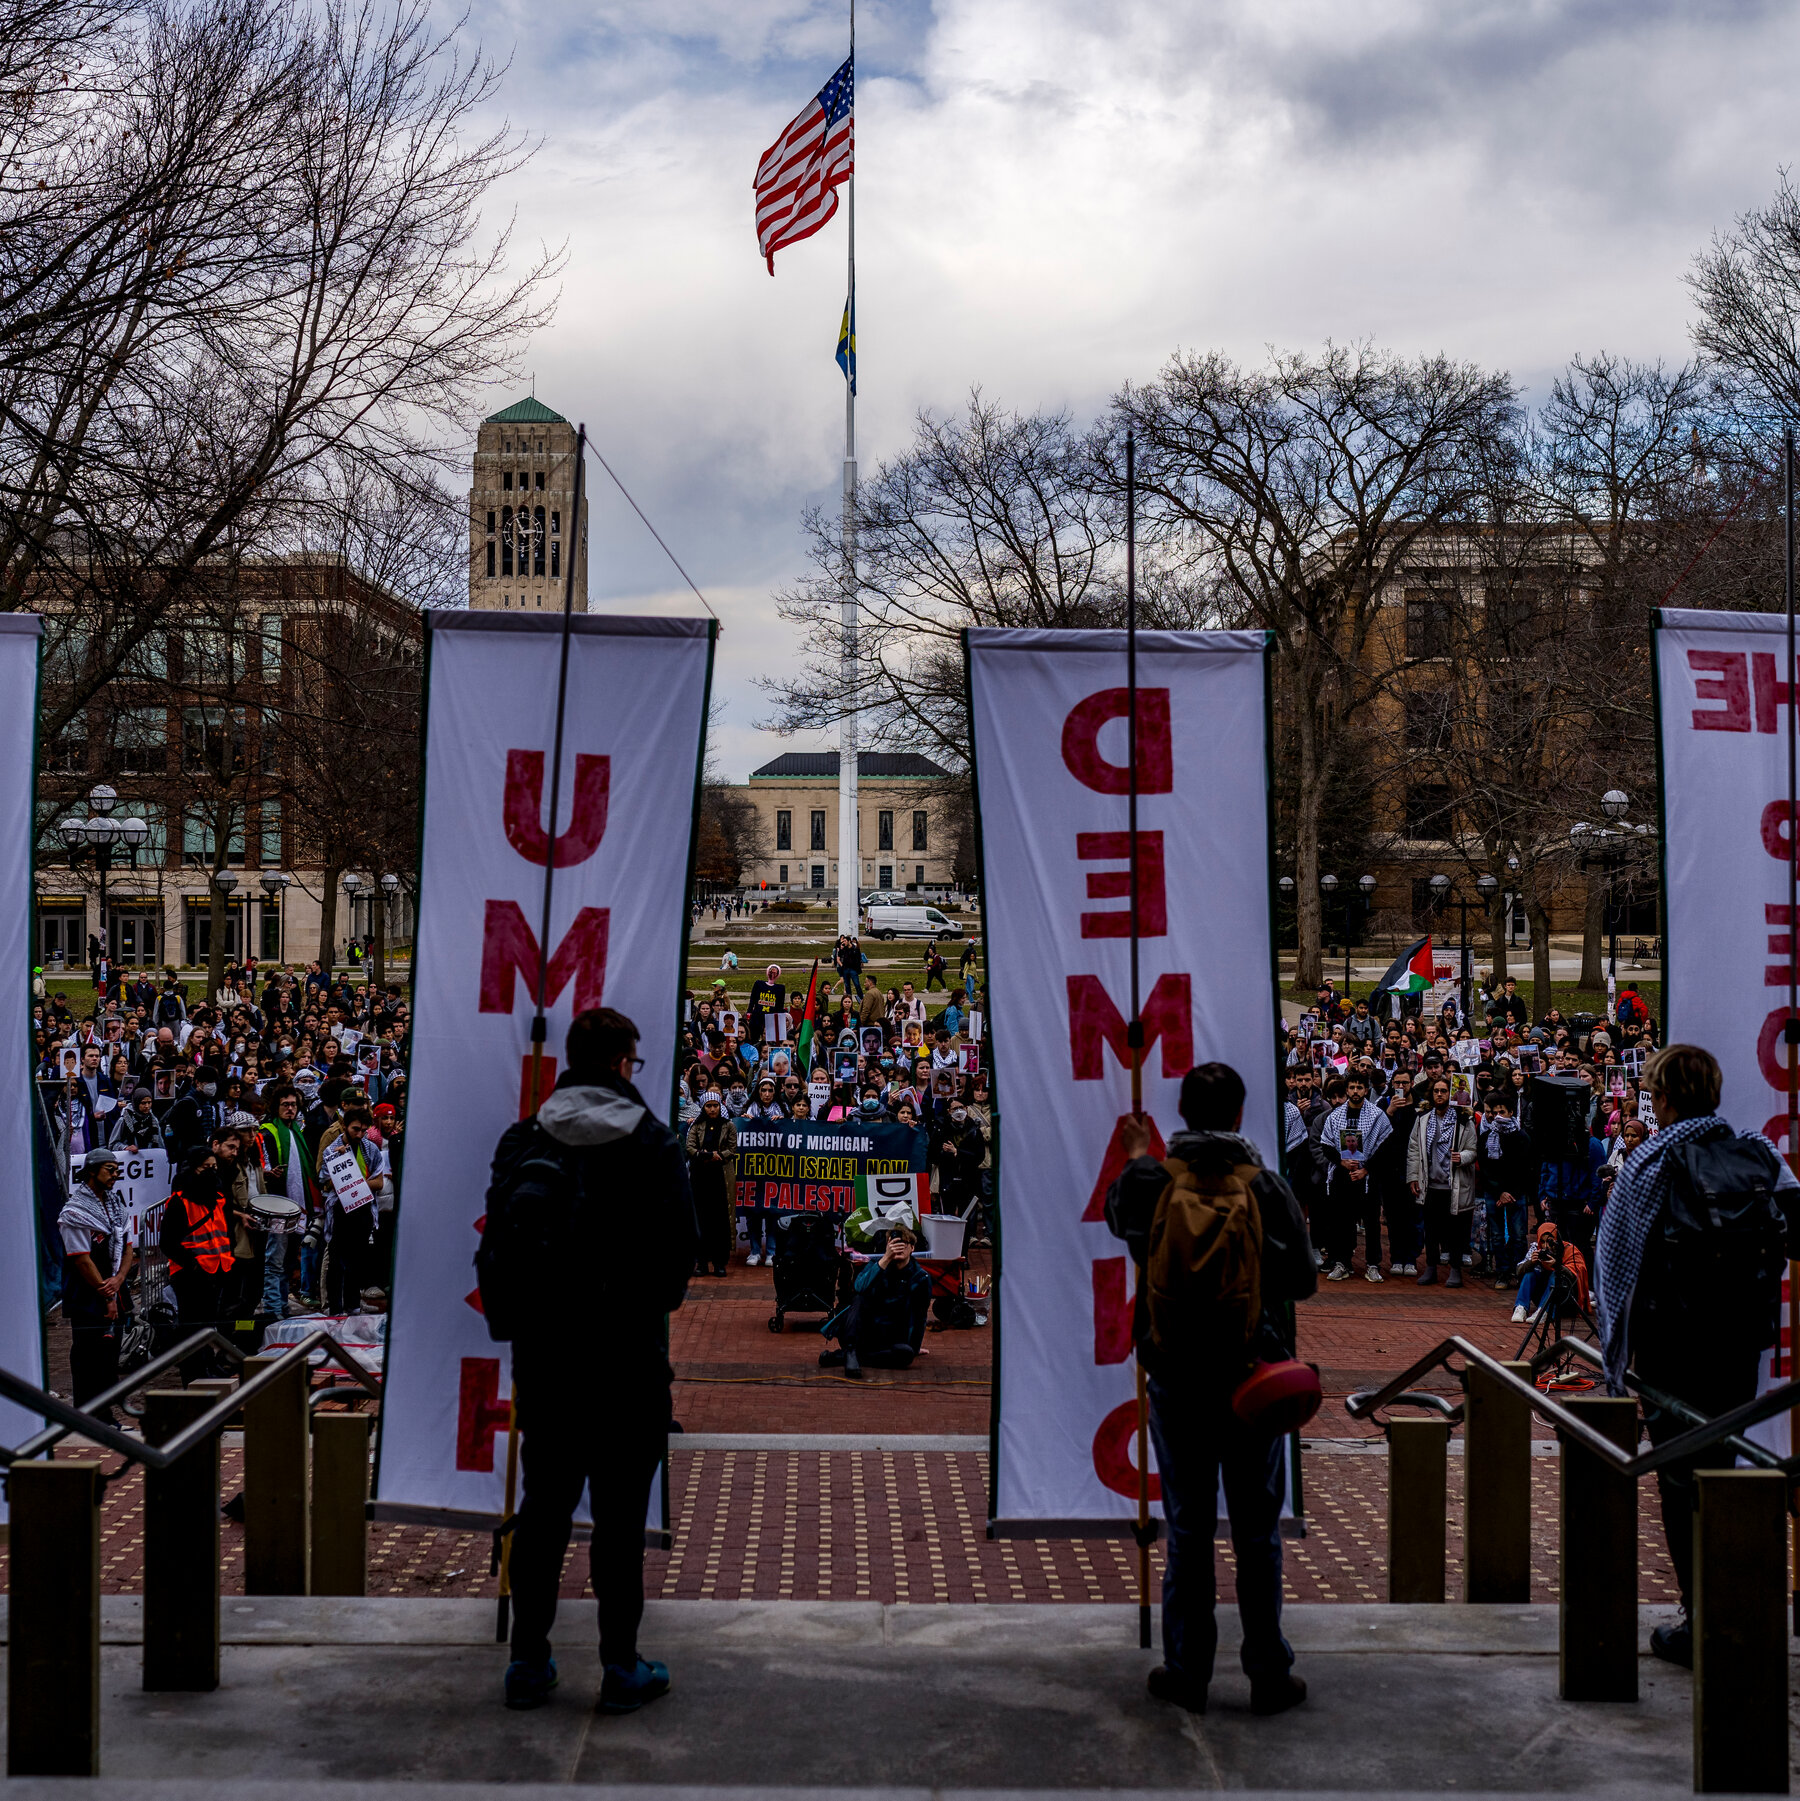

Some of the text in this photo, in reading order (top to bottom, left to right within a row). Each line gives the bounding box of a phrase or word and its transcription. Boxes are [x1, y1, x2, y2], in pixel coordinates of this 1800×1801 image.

[787, 1133, 803, 1150] OF
[806, 1135, 874, 1152] MICHIGAN:
[332, 1159, 354, 1175] JEWS
[744, 1152, 795, 1178] FROM
[866, 1158, 909, 1175] NOW
[340, 1173, 353, 1183] FOR
[350, 1190, 359, 1199] OF
[344, 1194, 374, 1213] PALESTINE
